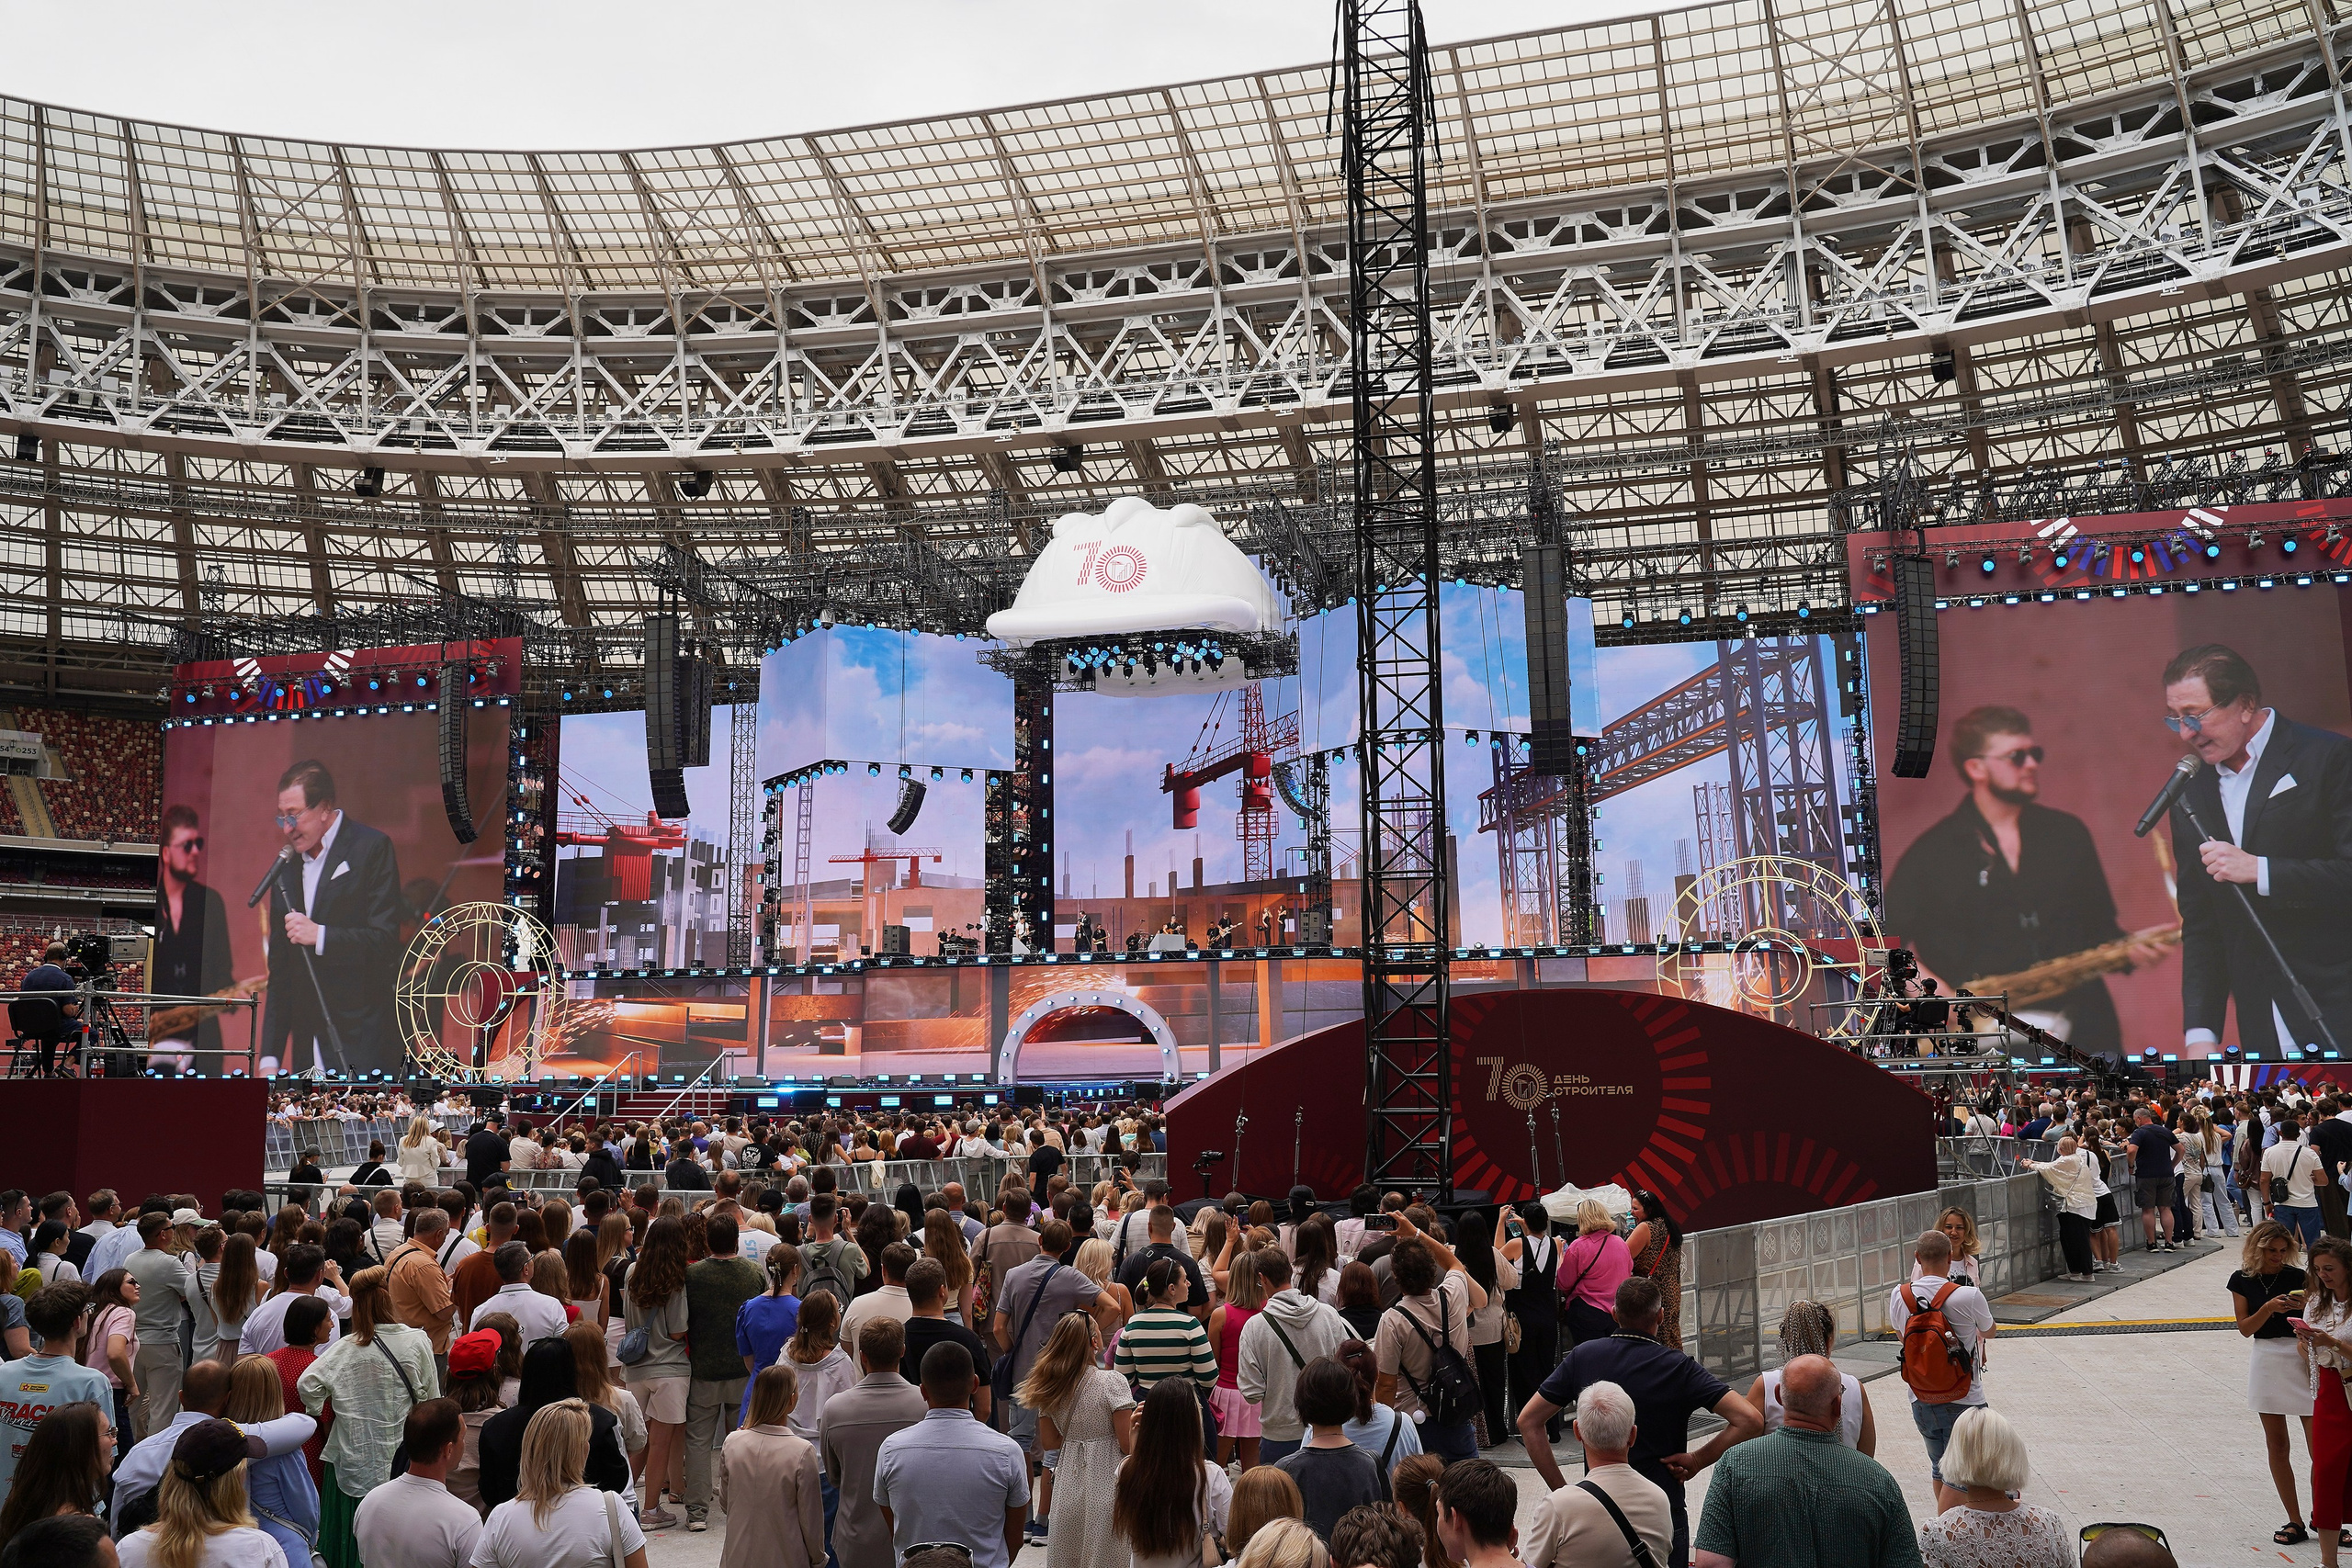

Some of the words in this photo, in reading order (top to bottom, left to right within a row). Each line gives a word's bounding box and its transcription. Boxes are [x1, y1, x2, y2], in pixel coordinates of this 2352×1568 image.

[22, 747, 37, 755] 253
[1554, 1075, 1590, 1084] ДЕНЬ
[1554, 1086, 1634, 1096] СТРОИТЕЛЯ
[0, 1400, 55, 1421] TRAC
